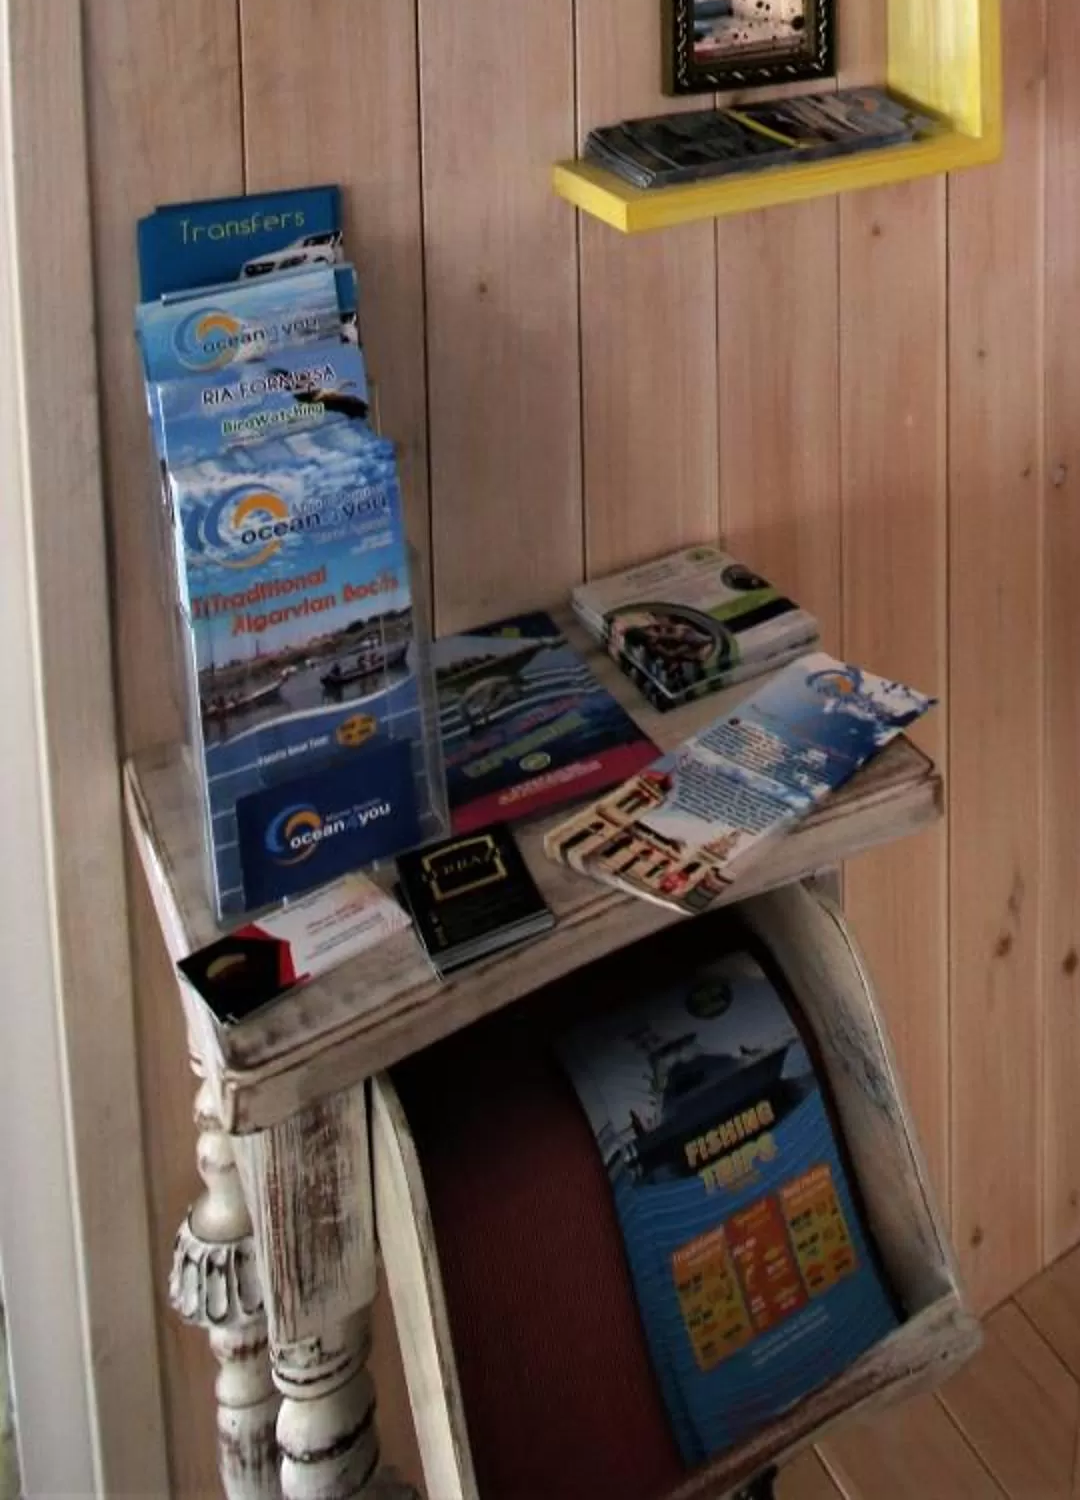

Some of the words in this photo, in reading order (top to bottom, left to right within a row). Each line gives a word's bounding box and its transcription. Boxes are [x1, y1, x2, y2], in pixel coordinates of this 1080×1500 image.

[179, 210, 306, 245] Transfers
[202, 384, 234, 406] RIA
[239, 362, 337, 400] FORMOSA
[232, 593, 337, 636] Algarvian
[684, 1099, 776, 1169] FISHING
